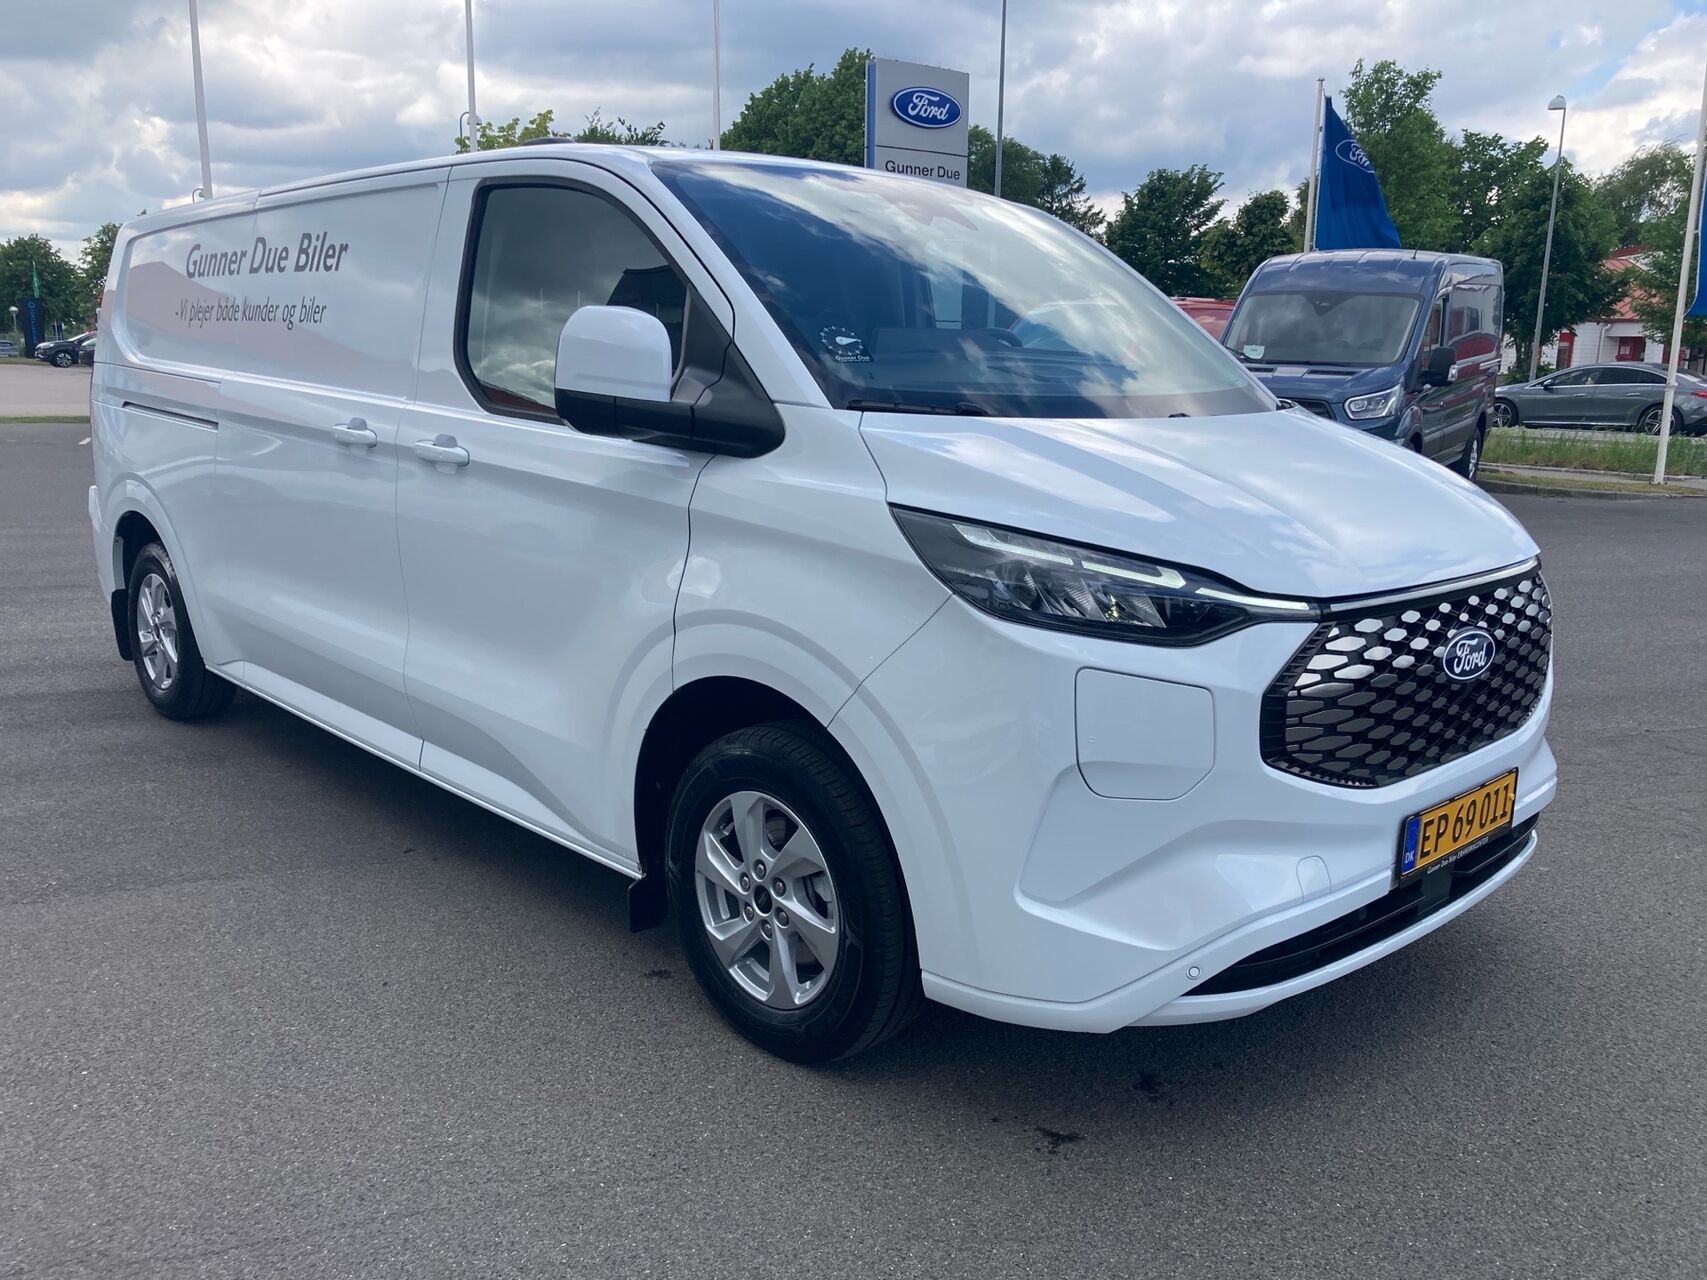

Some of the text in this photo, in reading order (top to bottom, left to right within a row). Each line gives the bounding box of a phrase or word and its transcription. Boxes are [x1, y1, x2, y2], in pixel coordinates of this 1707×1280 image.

[908, 92, 950, 120] Ford
[885, 160, 960, 180] Gunner Due
[186, 231, 349, 279] Gunner Due Biler
[188, 299, 215, 328] plejer
[216, 296, 240, 322] både
[241, 296, 280, 322] kunder
[282, 304, 297, 331] og
[299, 296, 327, 323] biler
[1454, 637, 1488, 674] Ford
[1420, 782, 1510, 859] EP 69 011
[1404, 849, 1415, 864] DK
